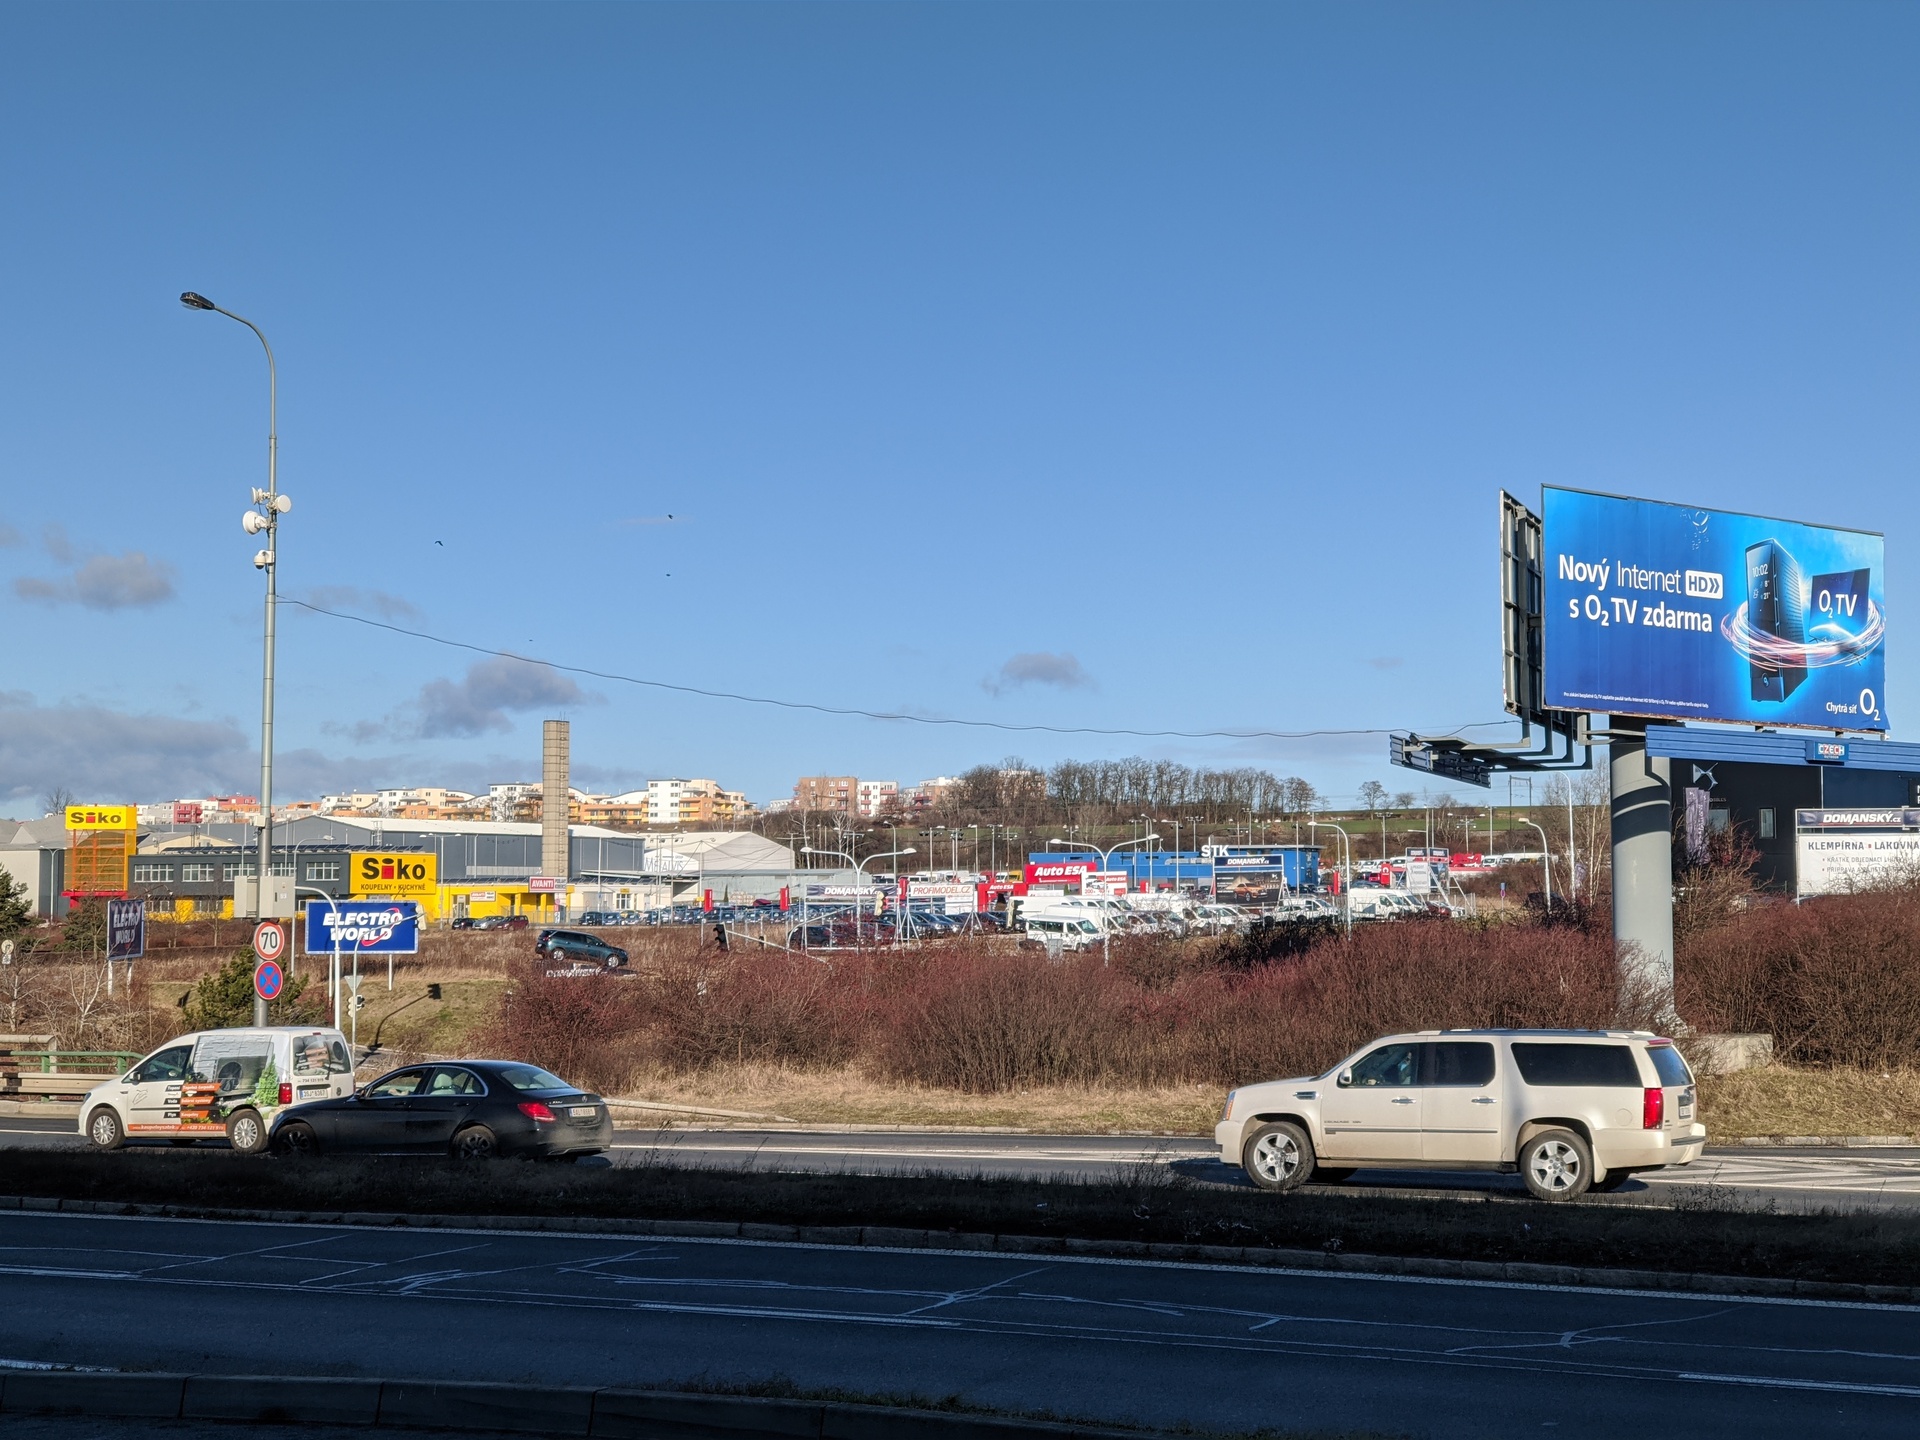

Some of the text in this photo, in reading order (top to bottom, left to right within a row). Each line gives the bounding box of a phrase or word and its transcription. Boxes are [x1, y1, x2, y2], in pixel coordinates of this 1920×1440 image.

[1559, 554, 1610, 591] Nový
[1617, 560, 1682, 595] Internet
[1751, 563, 1769, 578] 10:02
[1835, 594, 1858, 617] TV
[1569, 598, 1580, 619] s
[1610, 597, 1638, 624] TV
[1642, 601, 1713, 633] zdarma
[1826, 701, 1848, 715] Chytrá
[1817, 743, 1845, 756] CZECH
[1201, 845, 1229, 857] STK
[1808, 840, 1864, 851] KLEMPÍRNA
[1874, 841, 1919, 851] LAKOVNA
[361, 857, 426, 881] Siko
[1034, 865, 1087, 877] Auto ESA
[361, 883, 393, 891] KOUPELNY
[531, 880, 554, 889] AVANTI
[913, 886, 971, 895] PROFIMODEL.CZ
[112, 912, 139, 929] ELECTRO
[322, 912, 403, 927] ELECTRO
[115, 929, 136, 944] WORLD
[260, 931, 278, 950] 70
[330, 927, 392, 942] WORLD
